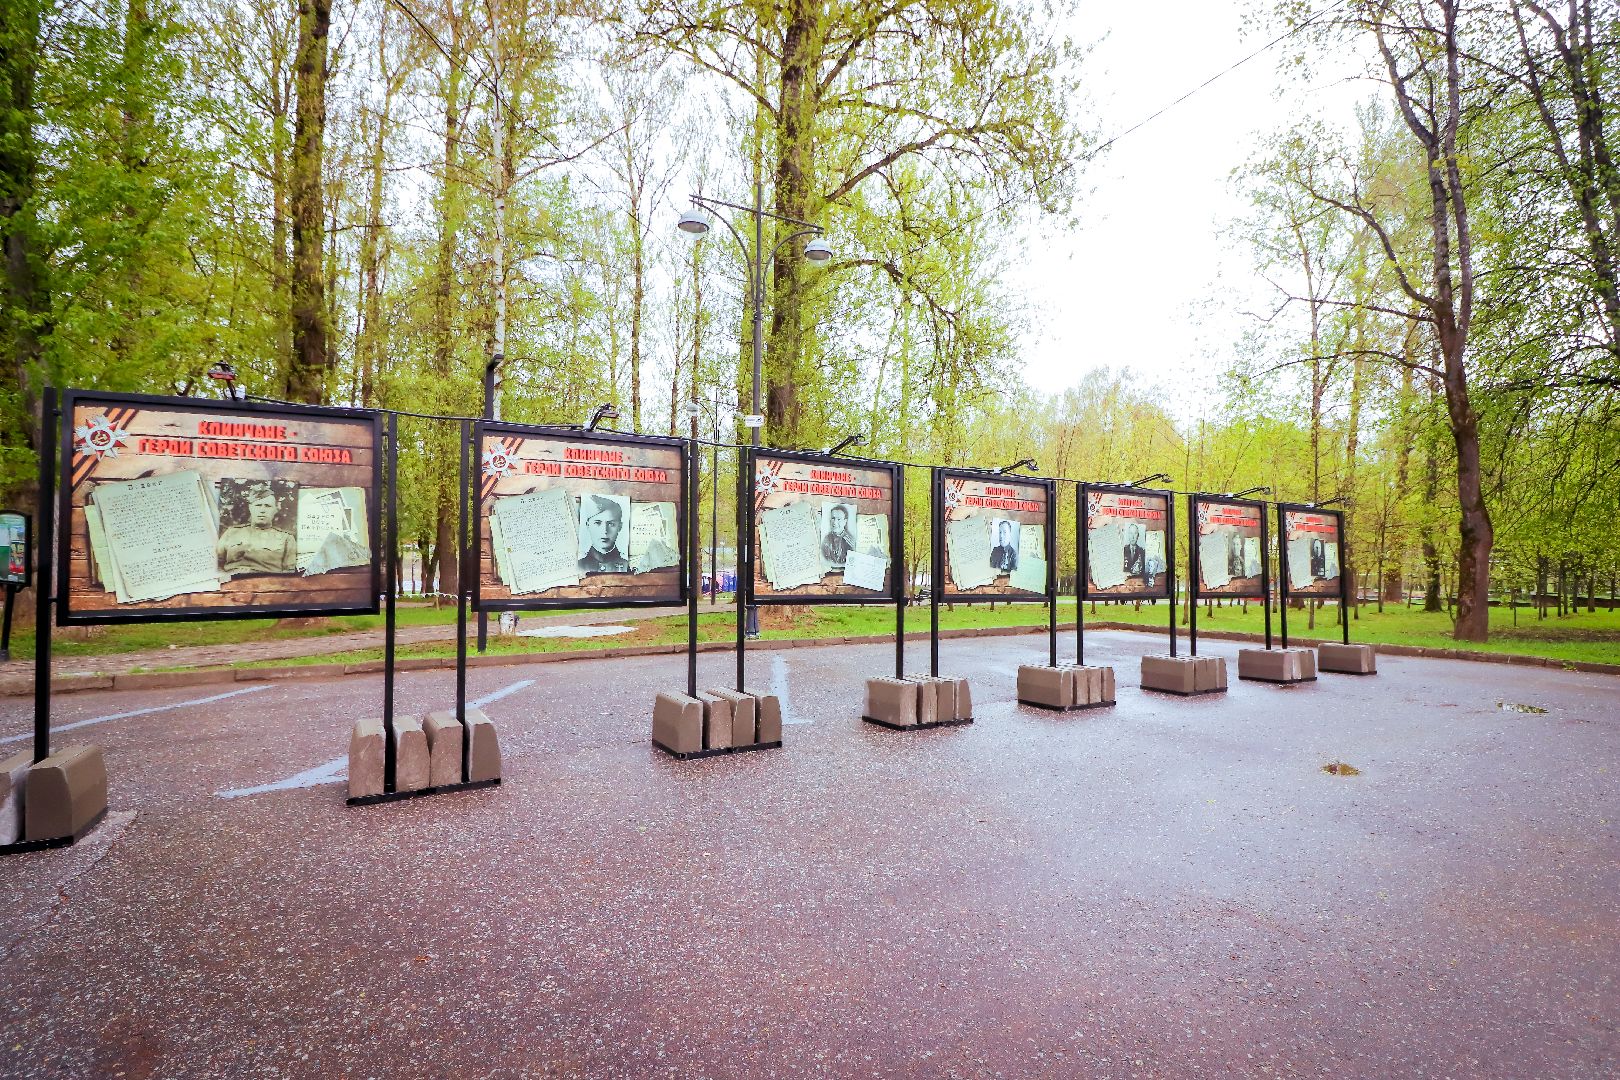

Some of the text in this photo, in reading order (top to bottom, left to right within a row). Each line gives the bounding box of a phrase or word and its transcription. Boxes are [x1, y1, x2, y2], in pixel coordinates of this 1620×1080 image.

[197, 421, 287, 440] КЛИНЧАНЕ
[138, 439, 353, 464] ГЕРОИ СОВЕТСКОГО СОЮЗА
[525, 462, 667, 482] ГЕРОИ СОВЕТСКОГО СОЮЗА
